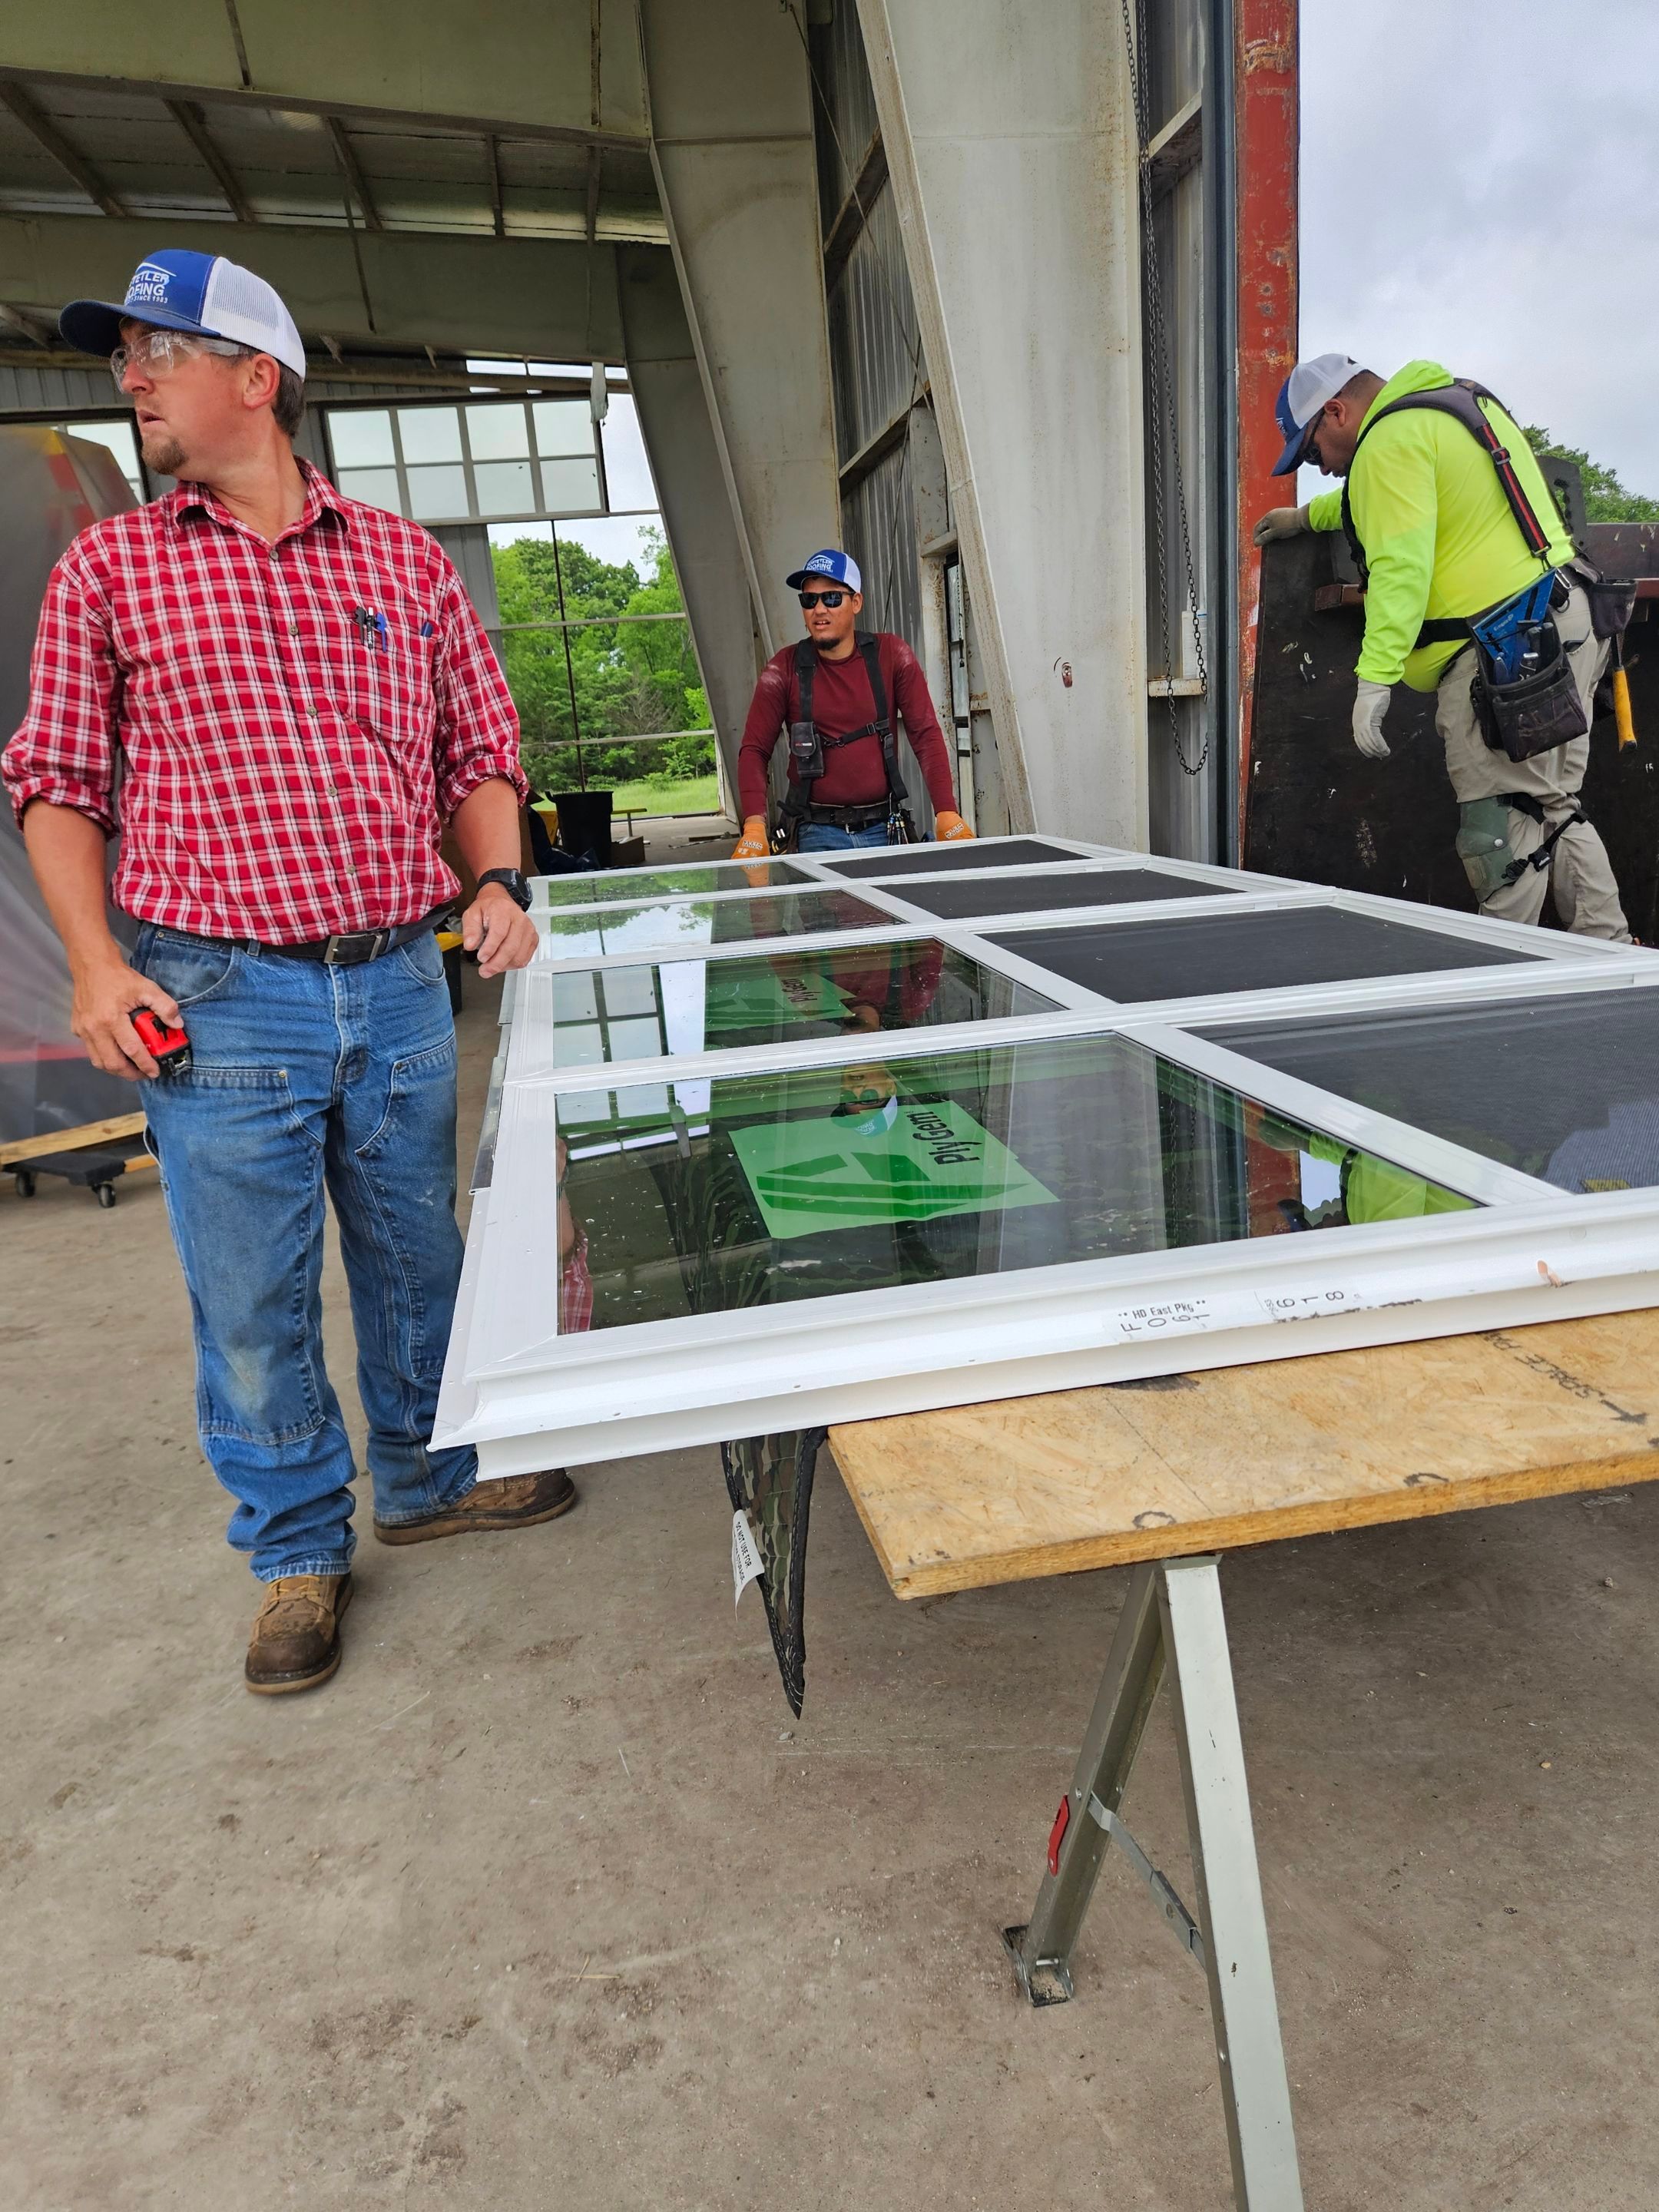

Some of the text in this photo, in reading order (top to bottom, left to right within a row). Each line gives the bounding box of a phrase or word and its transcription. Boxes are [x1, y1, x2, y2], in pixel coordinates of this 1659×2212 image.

[152, 296, 169, 304] 1983
[1132, 1303, 1195, 1320] HD East Pkg
[740, 1541, 749, 1556] USE
